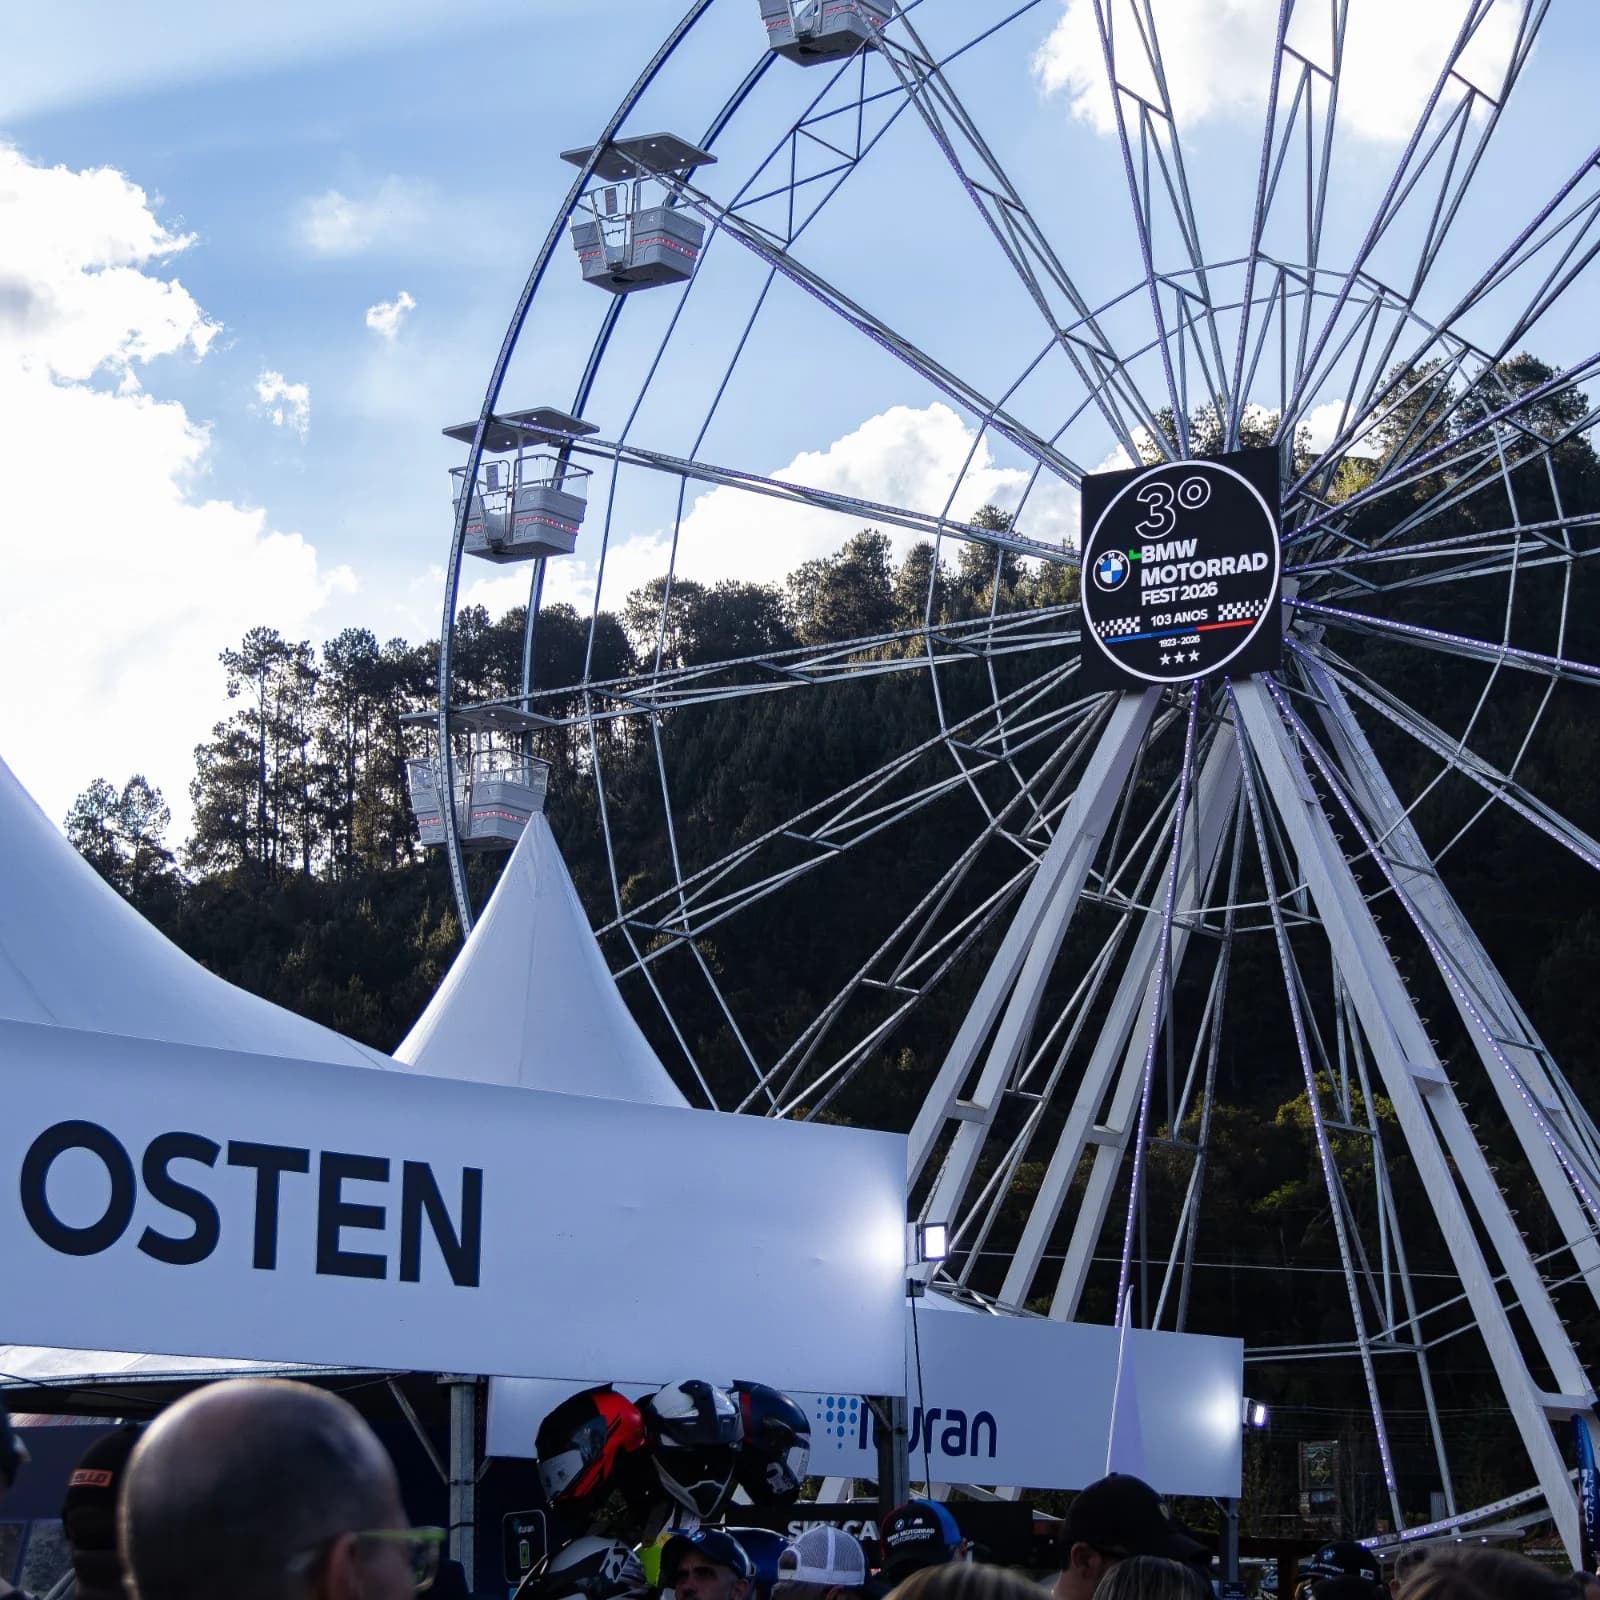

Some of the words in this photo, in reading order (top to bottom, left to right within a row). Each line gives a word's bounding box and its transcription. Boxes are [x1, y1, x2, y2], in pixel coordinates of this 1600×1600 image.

[1140, 537, 1198, 564] BMW
[1140, 552, 1269, 588] MOTORRAD
[1140, 587, 1179, 606] FEST
[1180, 581, 1219, 602] 2026
[1150, 614, 1172, 627] 103
[1173, 608, 1209, 624] ANOS
[21, 1119, 484, 1288] OSTEN
